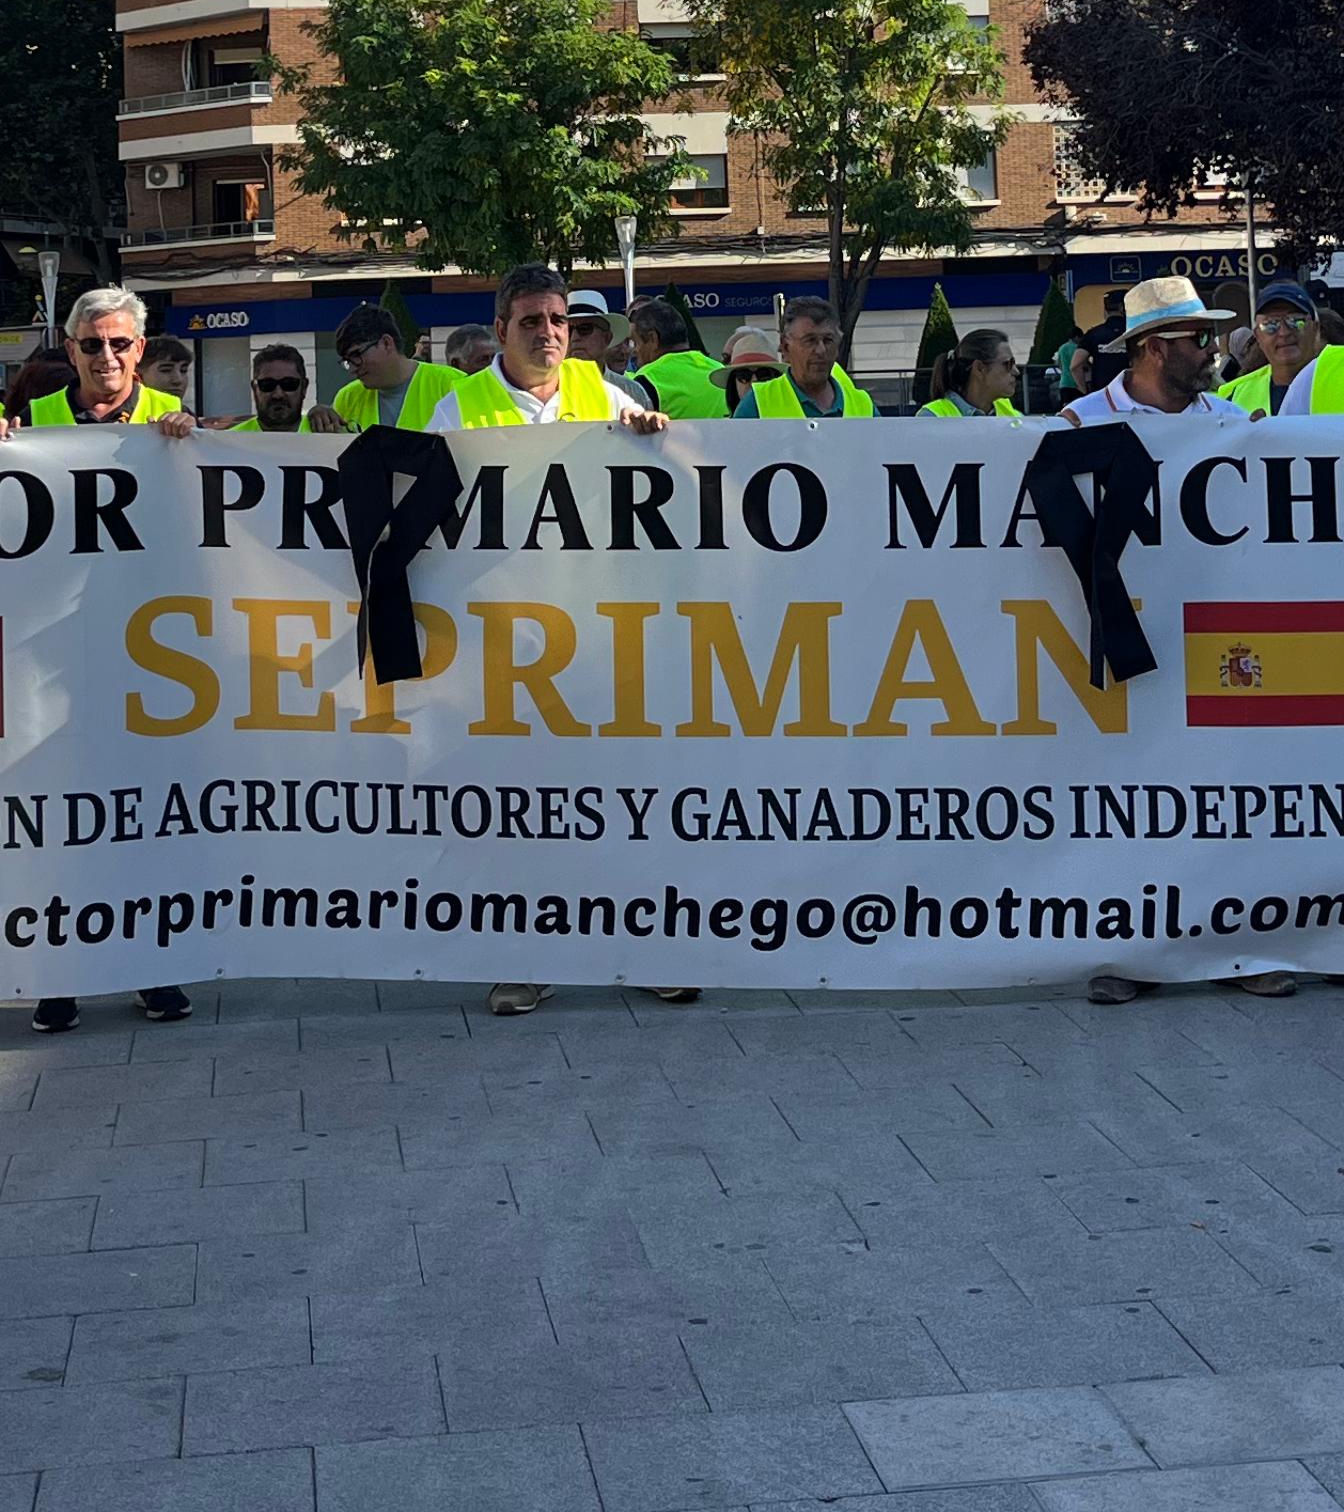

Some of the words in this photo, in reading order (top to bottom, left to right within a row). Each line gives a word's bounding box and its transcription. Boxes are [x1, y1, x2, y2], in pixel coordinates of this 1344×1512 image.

[1170, 253, 1279, 278] OCASO
[207, 311, 249, 329] OCASO
[197, 463, 827, 551] PRMARIO
[126, 596, 1142, 736] SEPRIMAN
[63, 787, 143, 846] DE
[155, 779, 605, 841] AGRICULTORES
[616, 788, 659, 841] Y
[672, 787, 1055, 841] GANADEROS
